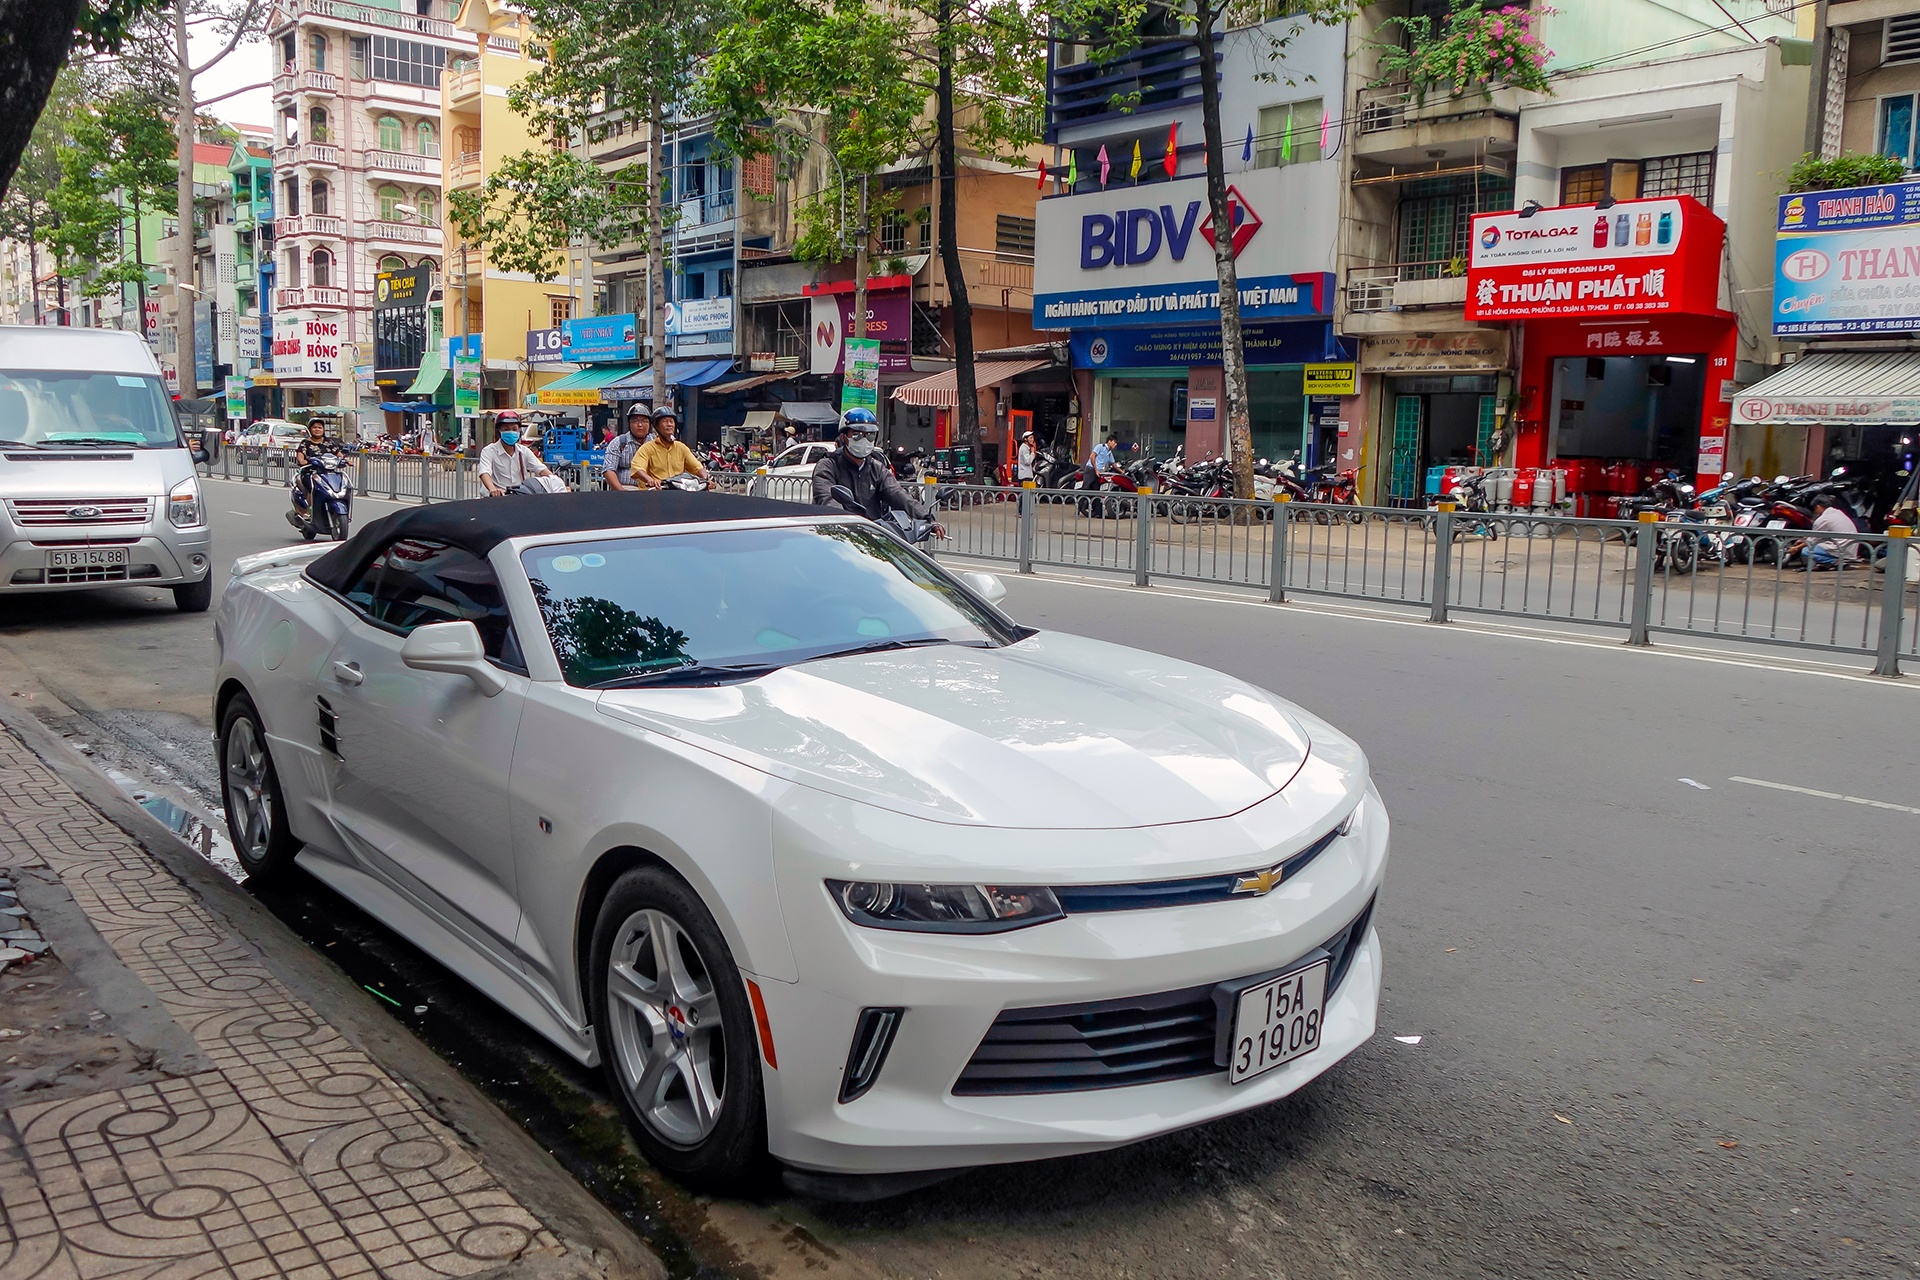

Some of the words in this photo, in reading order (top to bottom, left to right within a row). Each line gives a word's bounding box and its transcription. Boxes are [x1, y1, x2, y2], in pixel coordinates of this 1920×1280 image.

[1818, 196, 1864, 219] THANH
[1864, 189, 1896, 215] HẢO
[1080, 200, 1201, 269] BIDV
[1505, 226, 1578, 240] TOTALGAZ
[1522, 270, 1536, 278] ĐẠI
[1537, 268, 1547, 276] LÝ
[1548, 266, 1568, 275] KINH
[1568, 265, 1598, 274] DOANH
[1598, 264, 1616, 272] LPG
[1499, 278, 1573, 306] THUẬN
[1578, 274, 1641, 299] PHÁT
[1642, 268, 1665, 298] 順
[1857, 284, 1892, 300] CHỮA
[1045, 301, 1070, 318] NGÂN
[1071, 299, 1098, 316] HÀNG
[1098, 300, 1126, 316] TMCP
[1126, 292, 1148, 314] ĐẦU
[1149, 294, 1165, 312] TƯ
[1165, 292, 1178, 311] VÀ
[1179, 290, 1208, 310] PHÁT
[1242, 286, 1268, 308] VIỆT
[1269, 287, 1298, 305] NAM
[1562, 305, 1580, 313] QUẬN
[1878, 303, 1902, 316] TAY
[710, 312, 728, 320] PHONG
[306, 314, 338, 336] HỒNG
[306, 337, 338, 358] HỒNG
[1245, 340, 1268, 348] THÀNH
[1269, 338, 1282, 348] LẬP
[314, 362, 332, 373] 151
[1714, 358, 1728, 366] 181
[1774, 404, 1828, 416] THANH
[1834, 398, 1870, 416] HẢO
[54, 552, 122, 564] 51B-154.88
[1266, 976, 1304, 1024] 15A
[1236, 1008, 1319, 1074] 319.08
